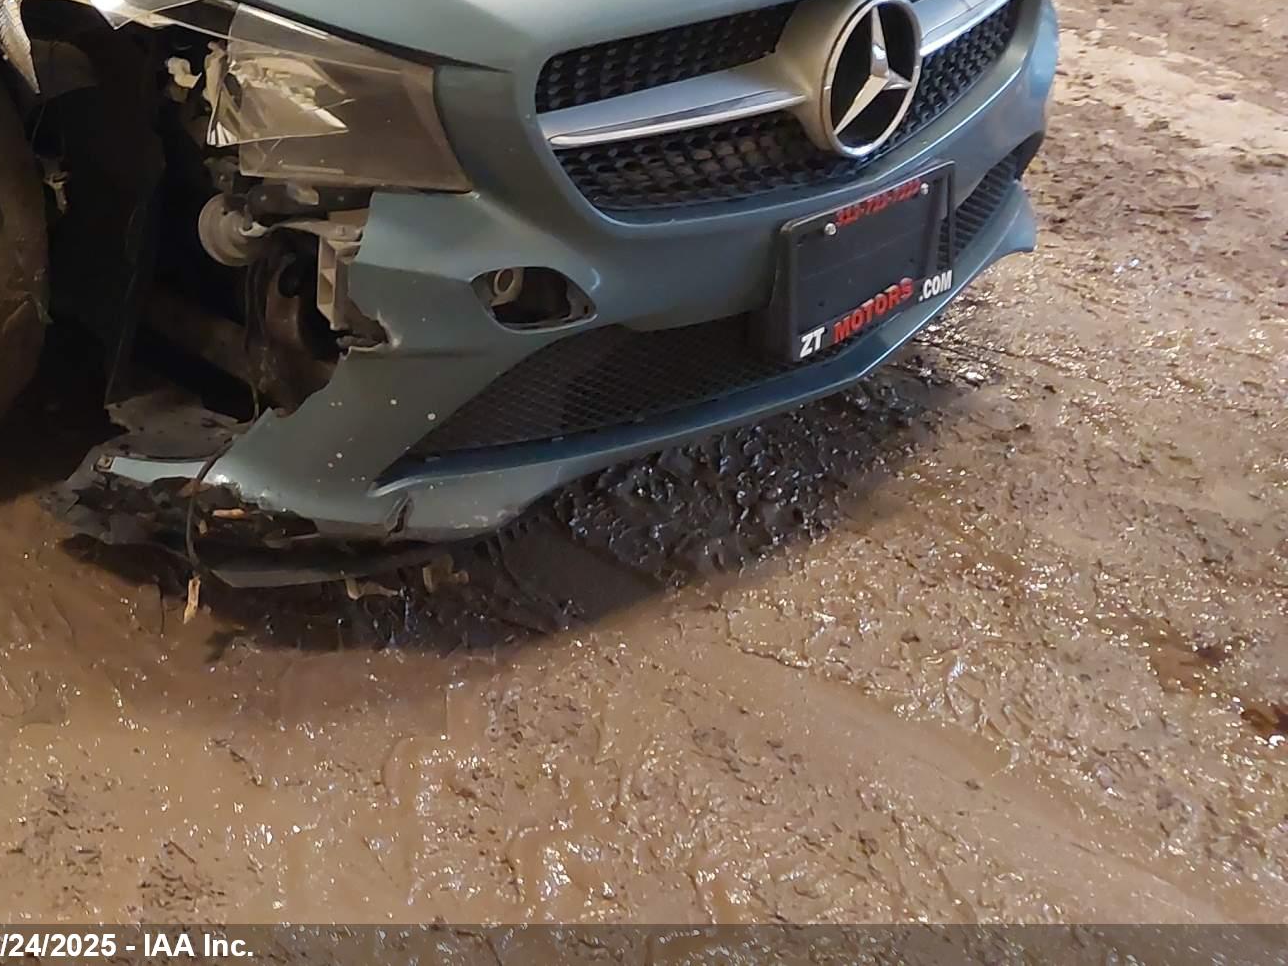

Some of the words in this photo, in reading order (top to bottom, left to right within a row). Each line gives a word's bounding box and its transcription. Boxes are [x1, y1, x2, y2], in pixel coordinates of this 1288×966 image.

[799, 326, 826, 359] ZT
[833, 277, 915, 343] MOTORS
[918, 270, 953, 302] .COM
